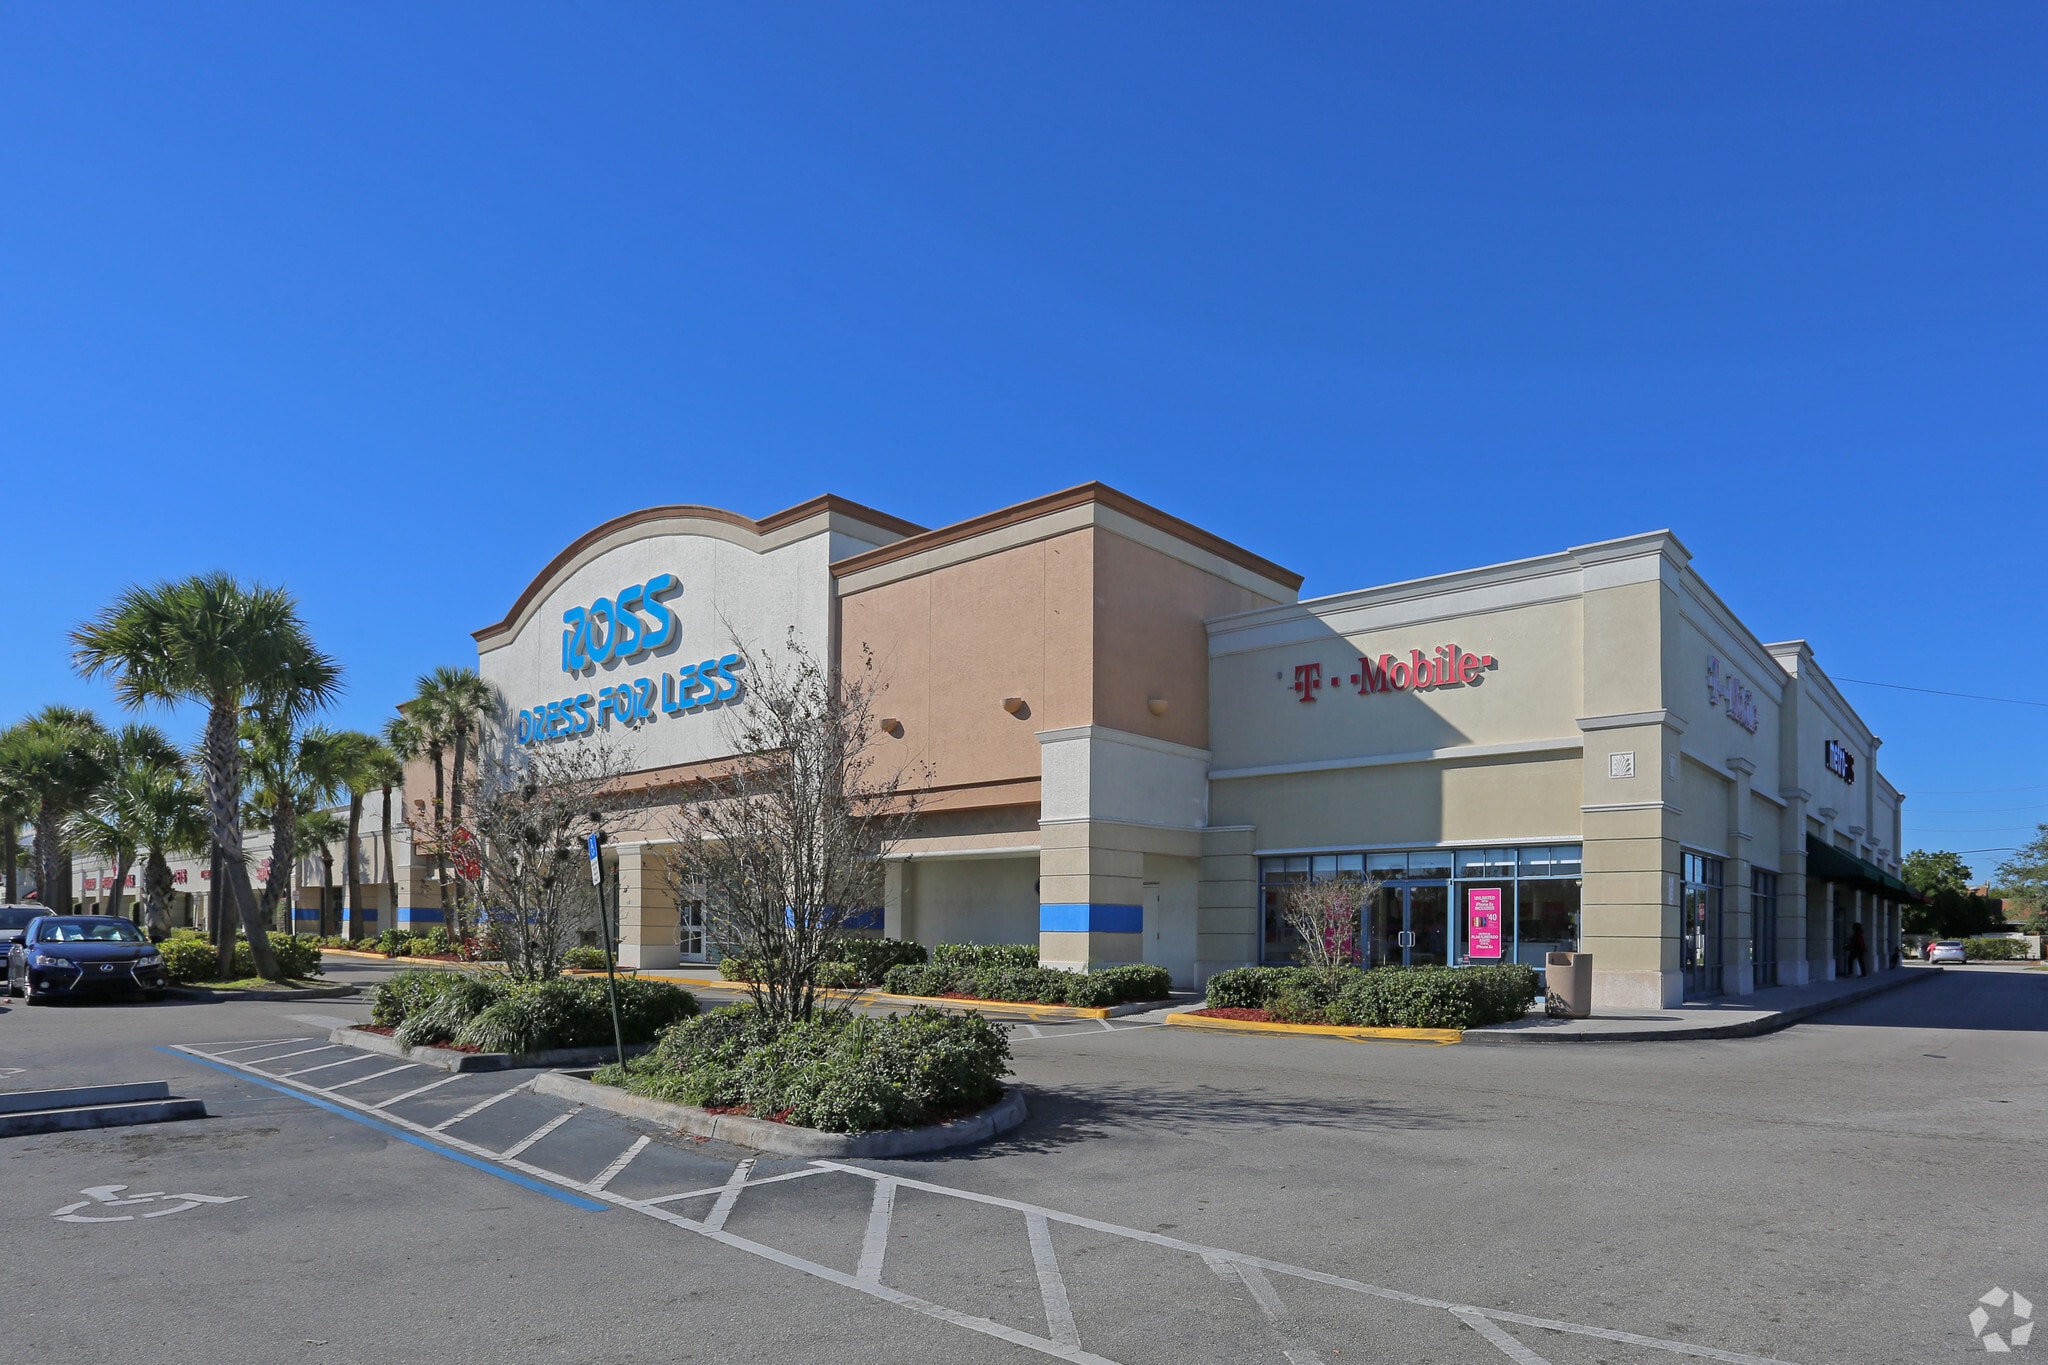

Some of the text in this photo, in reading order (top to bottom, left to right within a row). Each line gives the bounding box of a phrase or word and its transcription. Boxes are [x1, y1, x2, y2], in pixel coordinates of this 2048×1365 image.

[562, 573, 677, 673] ROSS
[518, 653, 742, 746] DRESS FOR LESS
